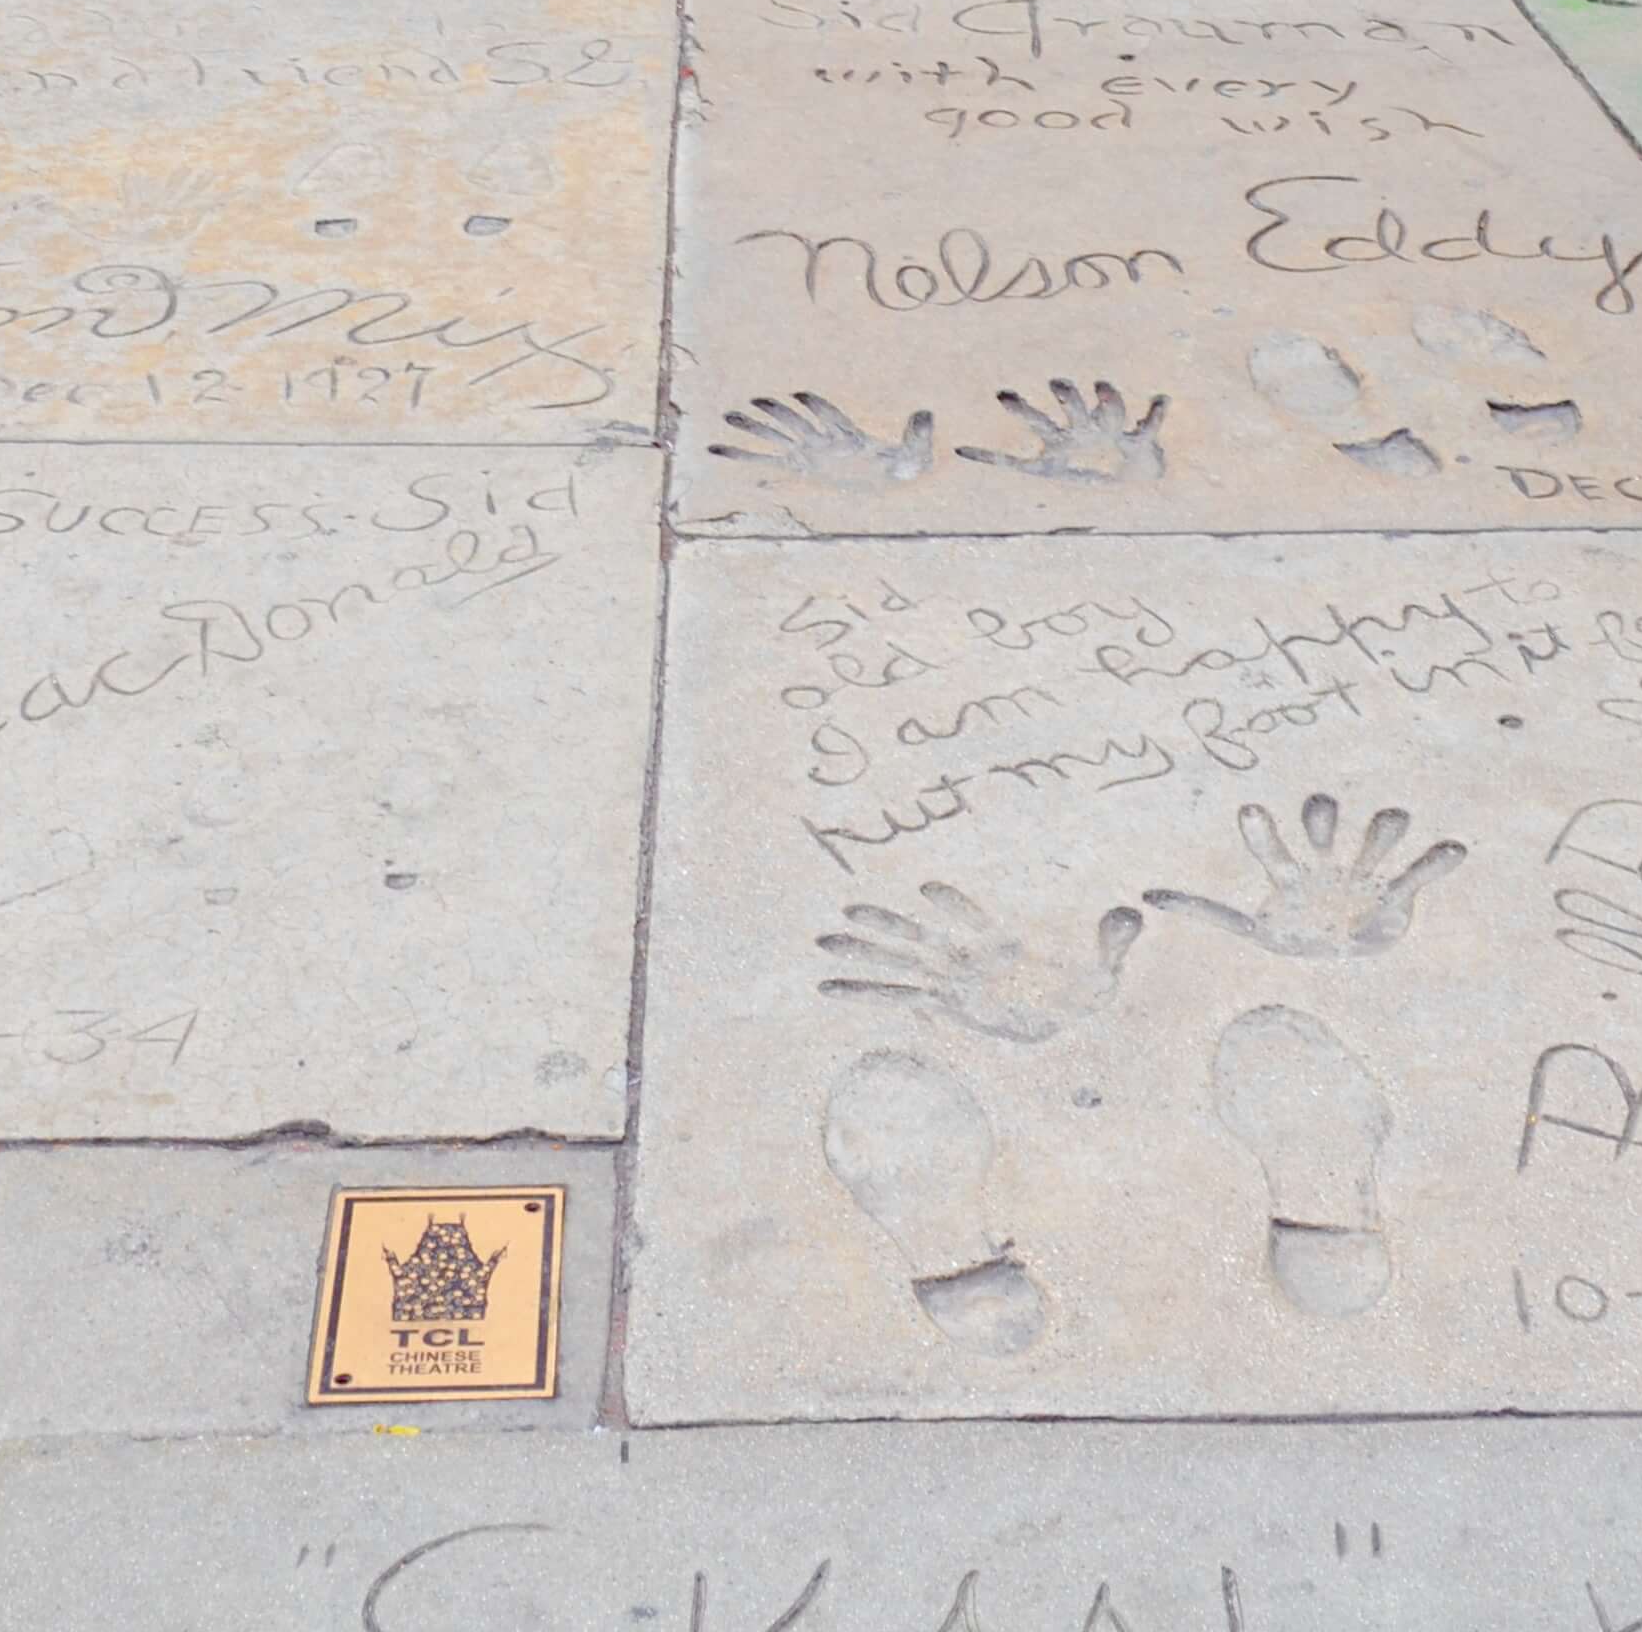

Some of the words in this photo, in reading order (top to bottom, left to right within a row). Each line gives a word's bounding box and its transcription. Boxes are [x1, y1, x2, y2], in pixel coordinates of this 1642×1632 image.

[737, 225, 1183, 310] Nelson
[390, 1328, 485, 1347] TCL
[390, 1350, 481, 1363] CHINESE
[388, 1362, 483, 1376] THEATRE
